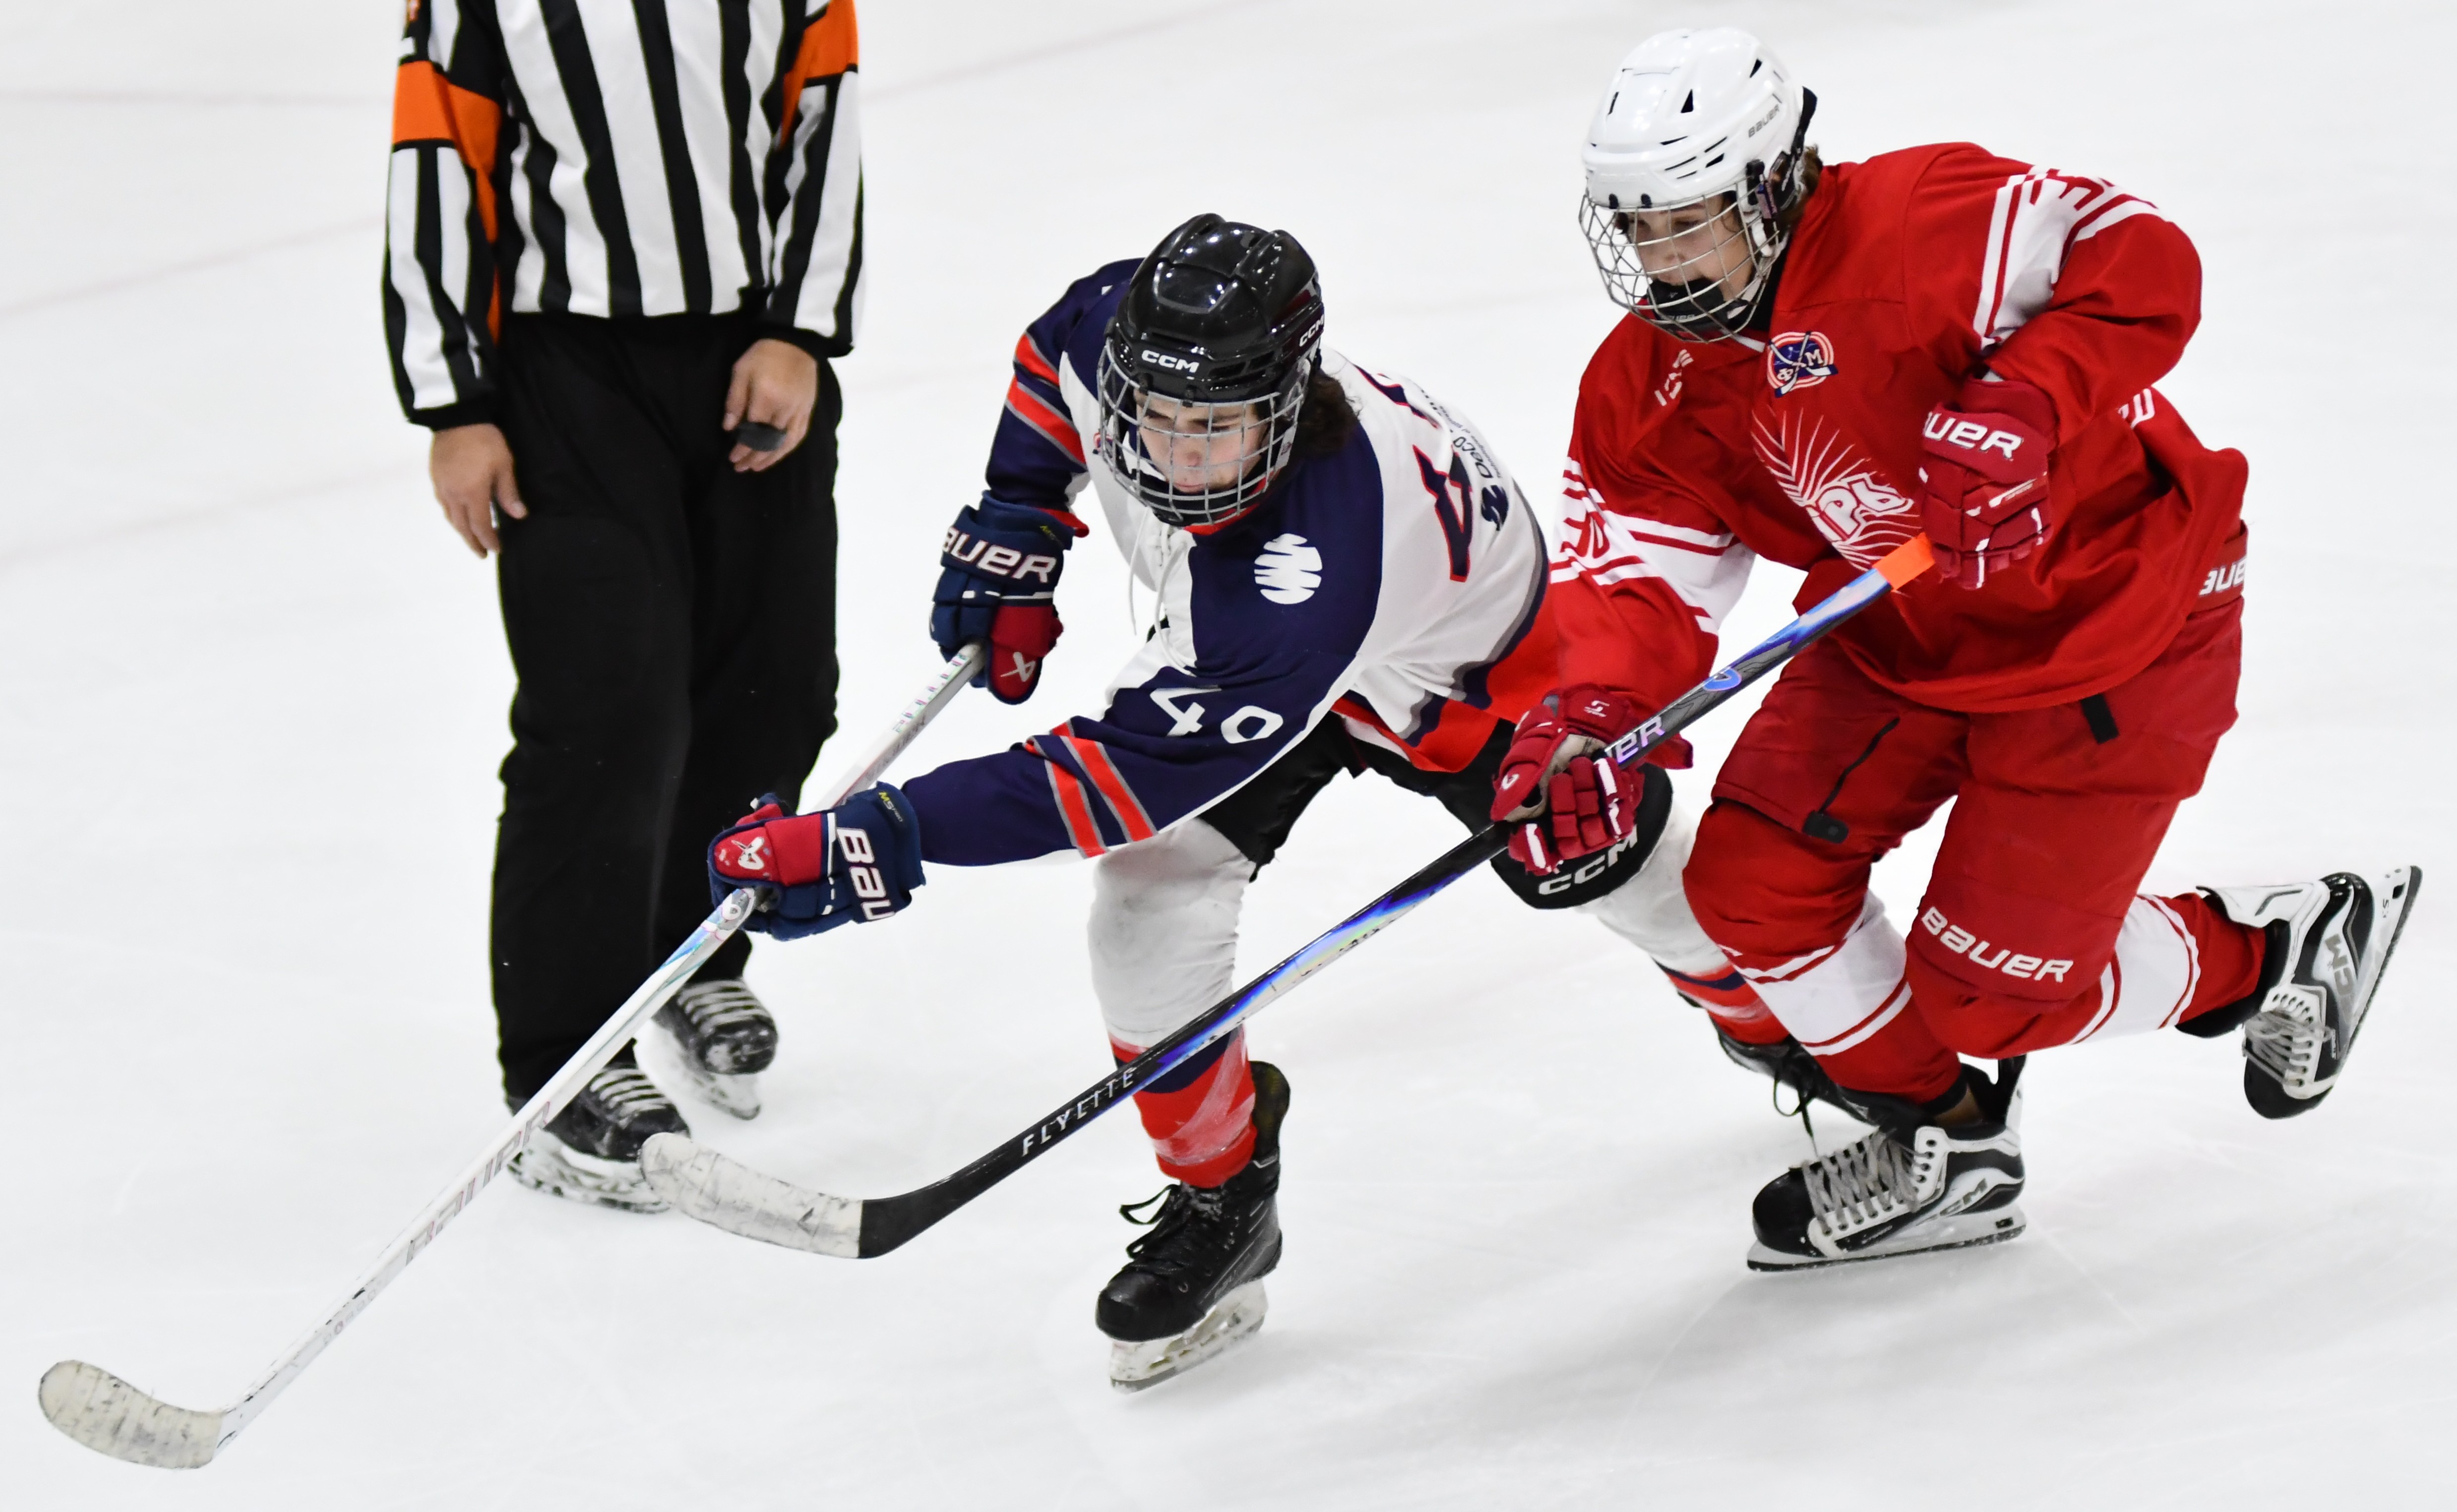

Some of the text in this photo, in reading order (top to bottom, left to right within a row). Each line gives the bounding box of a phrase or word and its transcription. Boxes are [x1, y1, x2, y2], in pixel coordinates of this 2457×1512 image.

[1299, 314, 1325, 347] CCM
[1141, 350, 1199, 373] CCM
[1923, 412, 2024, 460] UER
[1150, 685, 1284, 744] 40
[1538, 825, 1638, 895] CCM
[1921, 907, 2074, 983] BAUER
